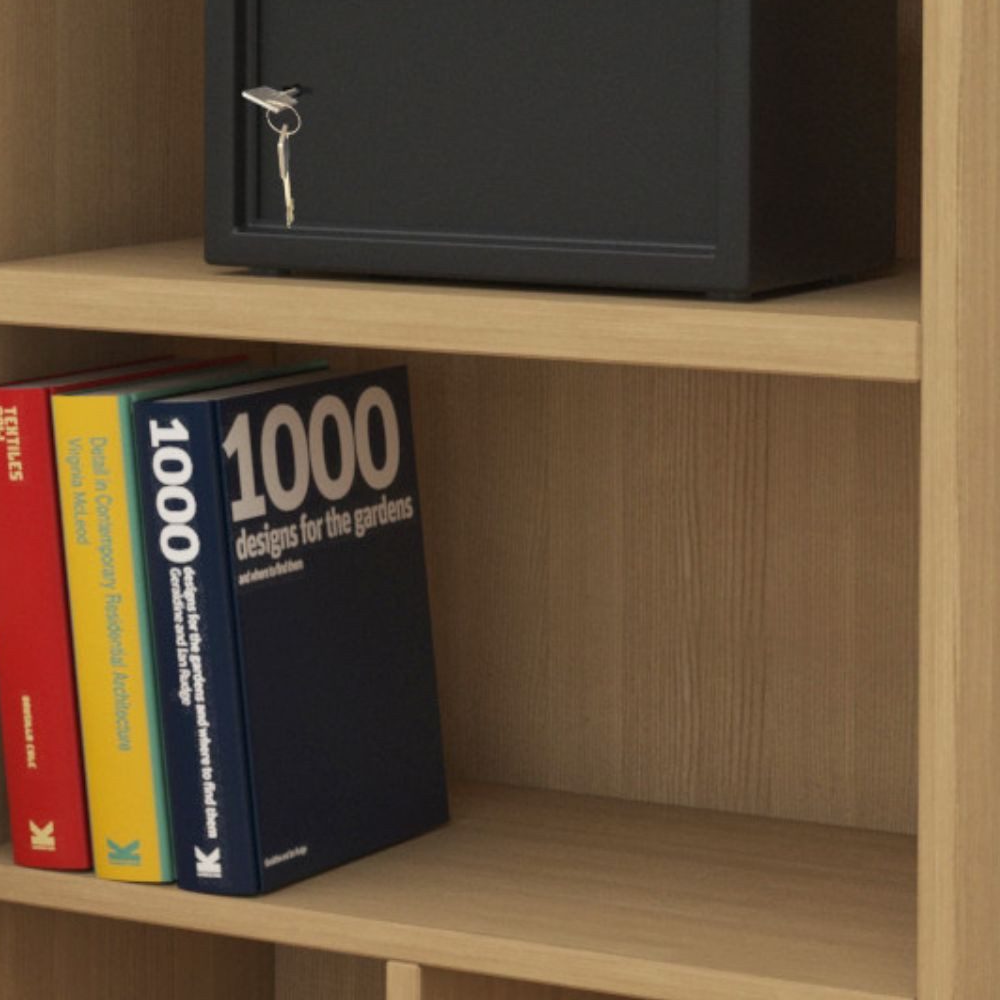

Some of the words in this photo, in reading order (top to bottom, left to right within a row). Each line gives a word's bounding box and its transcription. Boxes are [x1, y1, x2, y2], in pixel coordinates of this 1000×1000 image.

[3, 406, 24, 481] TEXTILES
[65, 437, 83, 487] Virginia
[89, 436, 110, 476] Detail
[222, 385, 401, 522] 1000
[148, 416, 201, 564] 1000
[72, 491, 92, 546] McLeod
[235, 522, 299, 561] designs
[300, 513, 325, 545] for
[325, 505, 352, 539] the
[353, 494, 414, 538] gardens
[95, 494, 117, 591] Contemporary
[169, 566, 185, 623] Geraldine
[182, 566, 198, 612] designs
[104, 592, 128, 668] Residential
[174, 622, 189, 647] and
[187, 613, 201, 632] for
[189, 632, 202, 652] the
[177, 647, 190, 668] Ian
[178, 668, 193, 707] Rudge
[189, 654, 206, 702] gardens
[112, 671, 132, 751] Architecture
[195, 703, 210, 725] and
[197, 727, 212, 765] where
[201, 766, 213, 781] to
[203, 781, 218, 805] find
[29, 820, 56, 848] K
[205, 806, 219, 838] them
[106, 837, 141, 863] K
[194, 845, 222, 875] K
